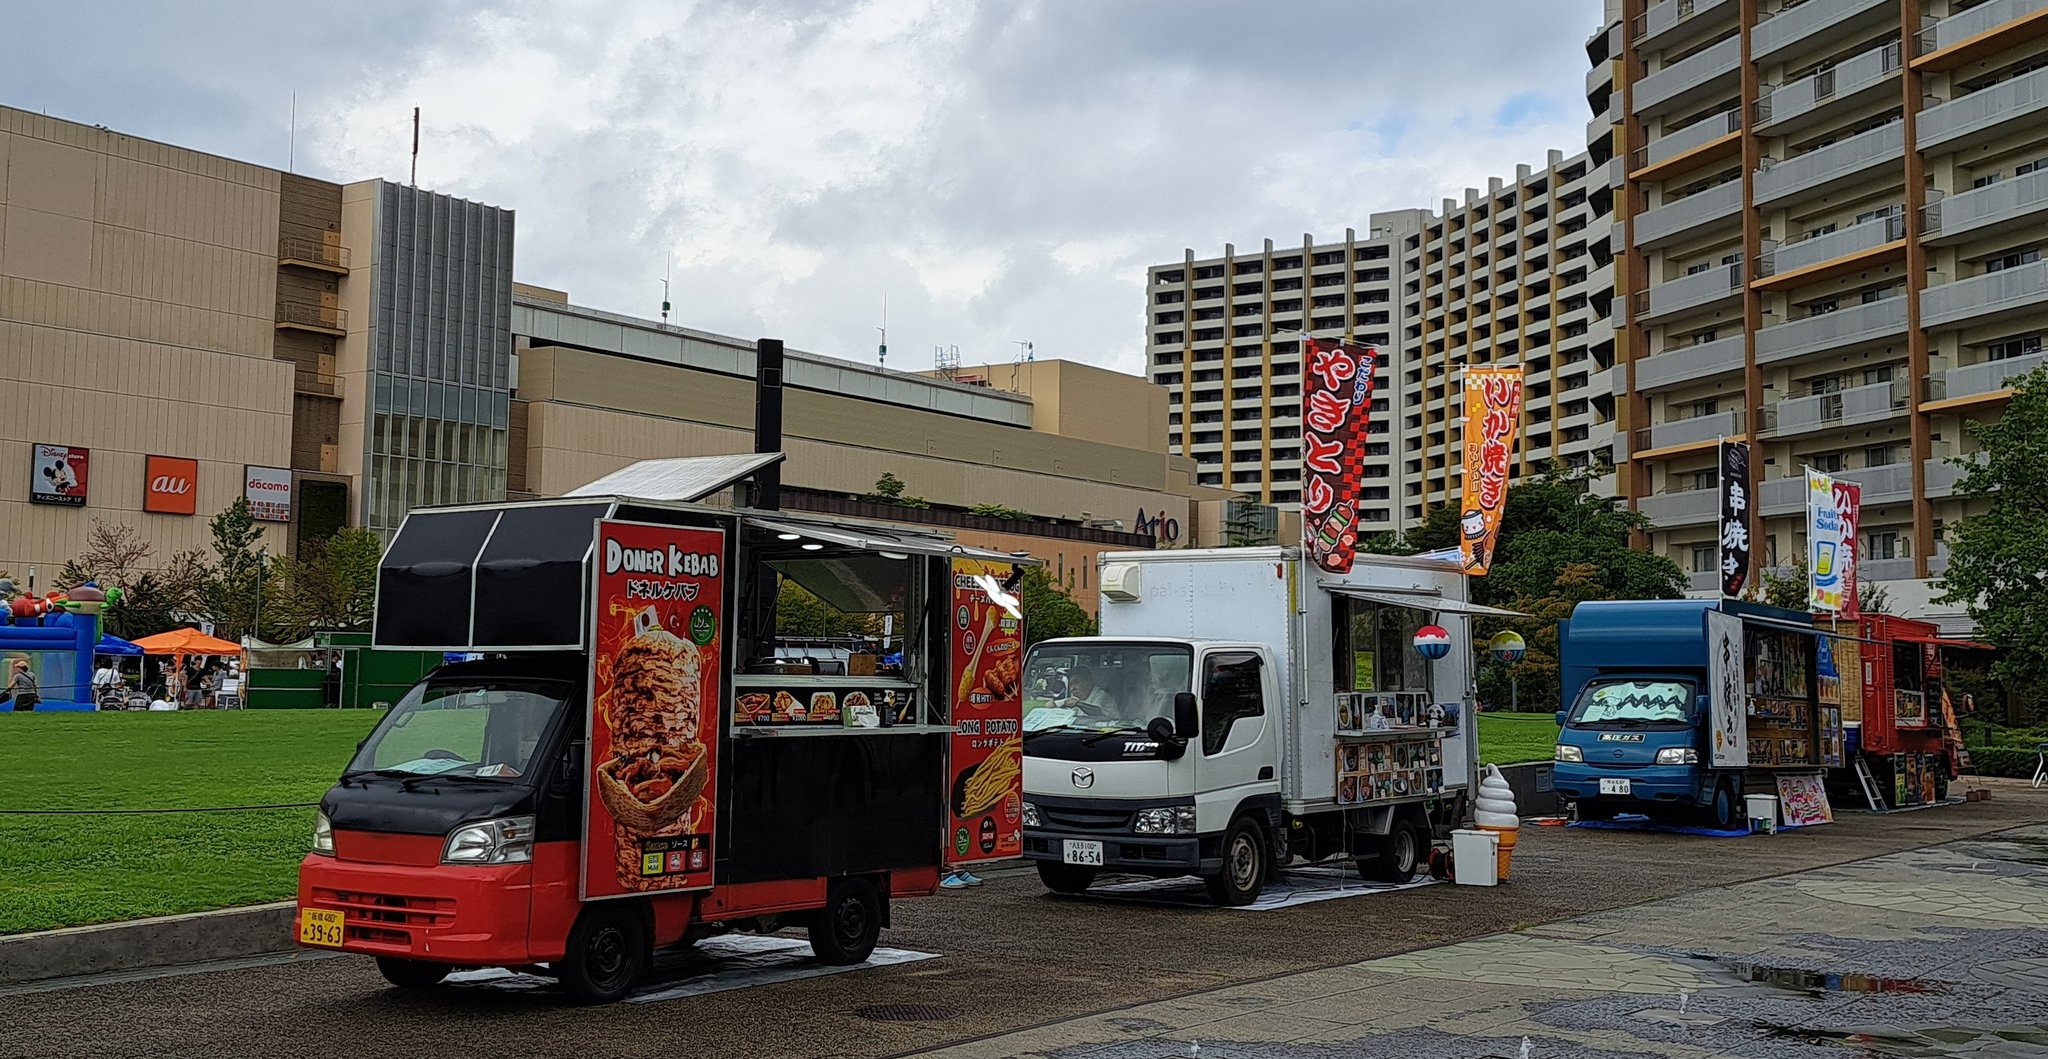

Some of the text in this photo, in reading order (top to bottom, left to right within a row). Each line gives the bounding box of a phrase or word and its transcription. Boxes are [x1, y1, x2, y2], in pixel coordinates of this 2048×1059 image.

[1353, 355, 1373, 405] こだわり
[1306, 349, 1356, 514] やきとり
[1480, 376, 1510, 508] いか焼き
[40, 446, 67, 460] Disney
[152, 476, 192, 494] au
[248, 479, 289, 492] docomo
[37, 494, 71, 502] ディズニーストア
[1817, 507, 1839, 519] Fruit
[1134, 507, 1179, 541] Ario
[1722, 481, 1749, 580] 串焼き
[1816, 518, 1839, 531] Soda
[606, 539, 719, 577] DONER KEBAB
[627, 579, 700, 600] ドネルケバブ
[957, 719, 1018, 735] LONG POTATO
[671, 839, 688, 849] ソース
[1072, 850, 1101, 864] 86-54
[310, 923, 342, 944] 39-63
